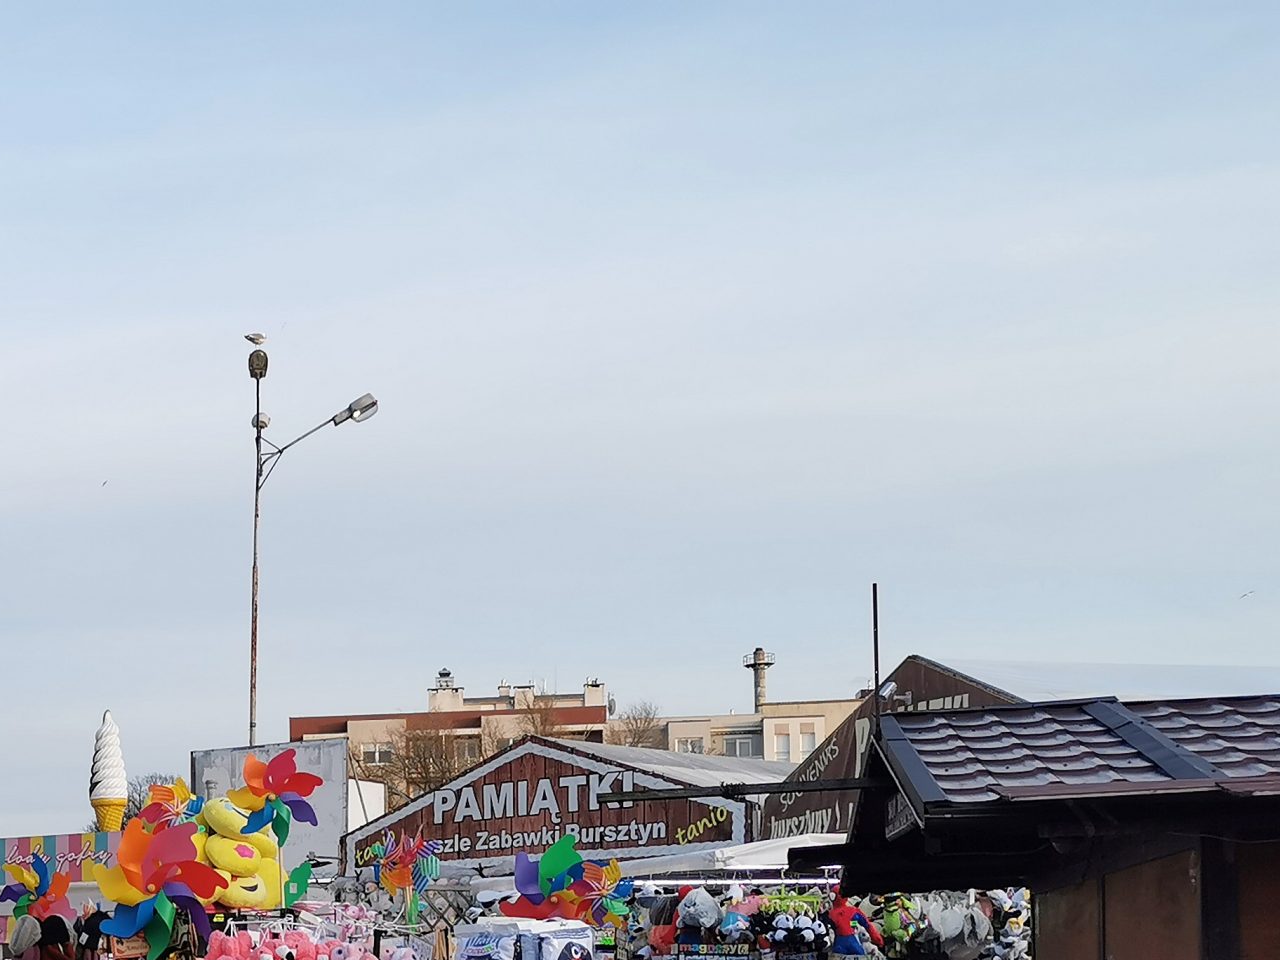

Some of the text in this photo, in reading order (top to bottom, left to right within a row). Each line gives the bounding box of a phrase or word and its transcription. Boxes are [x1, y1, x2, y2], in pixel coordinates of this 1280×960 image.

[433, 770, 634, 824] PAMIĄTKI
[475, 826, 560, 851] Zabawki
[565, 819, 667, 845] Bursztyn
[675, 804, 731, 846] tanio
[56, 841, 113, 872] gofry
[356, 829, 396, 865] taio
